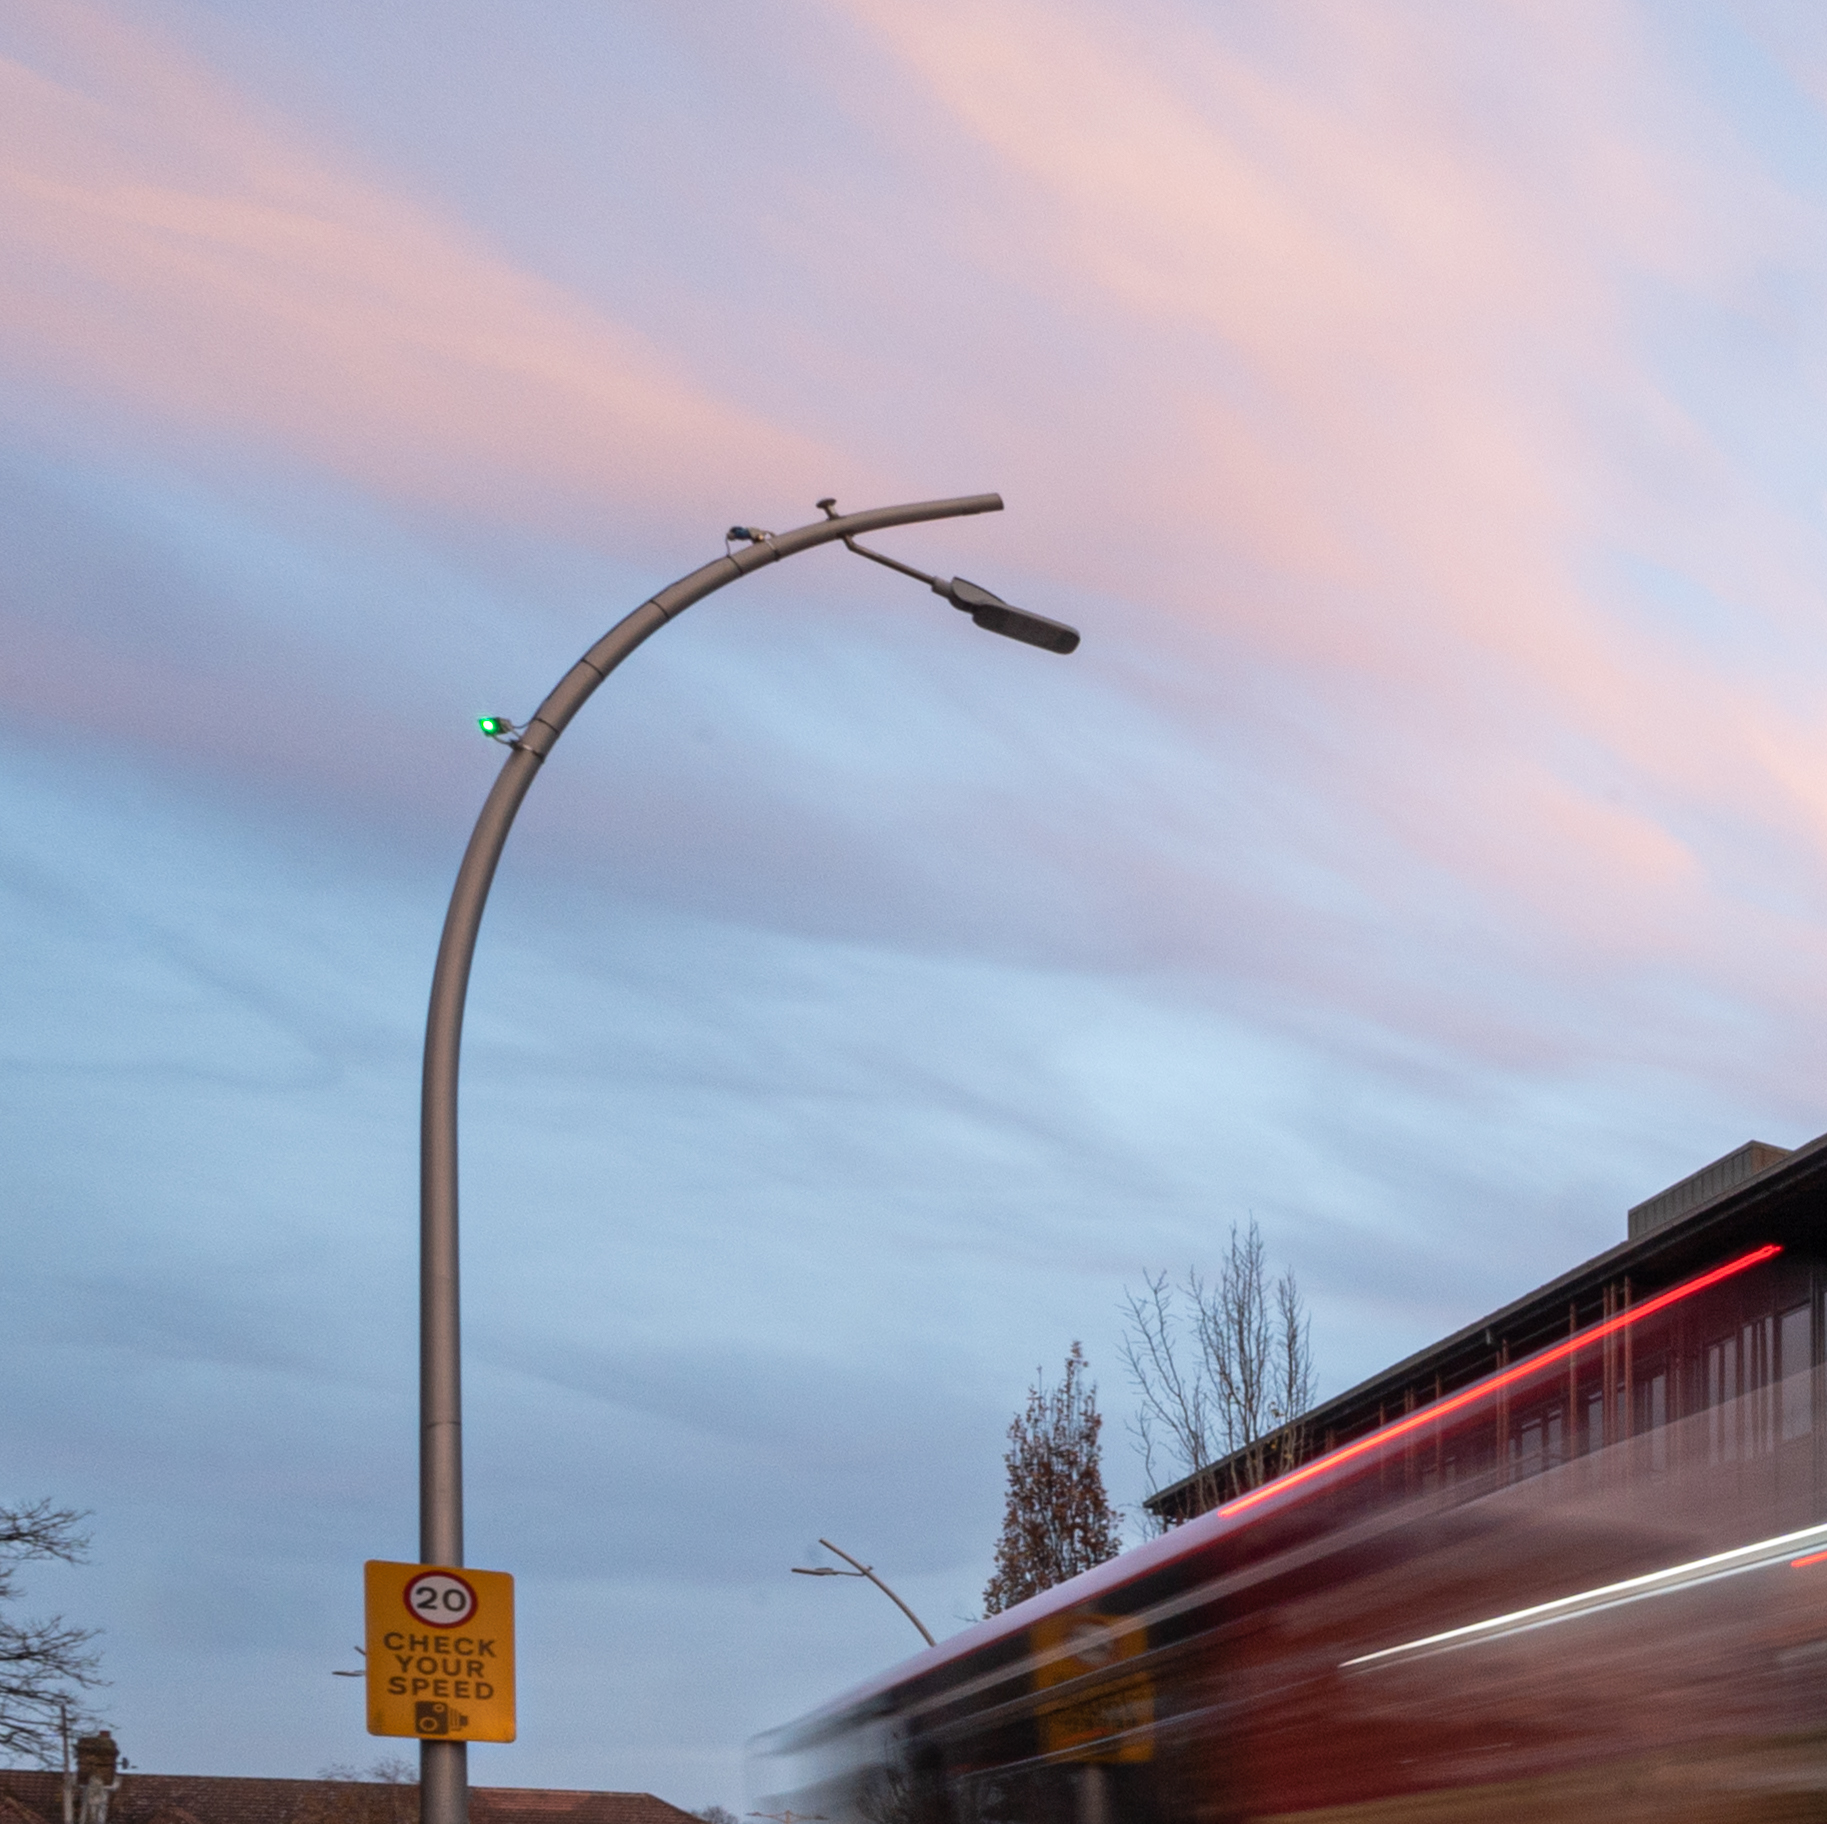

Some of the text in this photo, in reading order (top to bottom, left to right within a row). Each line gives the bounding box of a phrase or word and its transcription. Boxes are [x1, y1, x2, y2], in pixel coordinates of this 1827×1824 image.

[415, 1586, 467, 1612] 20
[383, 1631, 497, 1658] CHECK
[395, 1654, 485, 1678] YOUR
[387, 1676, 495, 1701] SPEED
